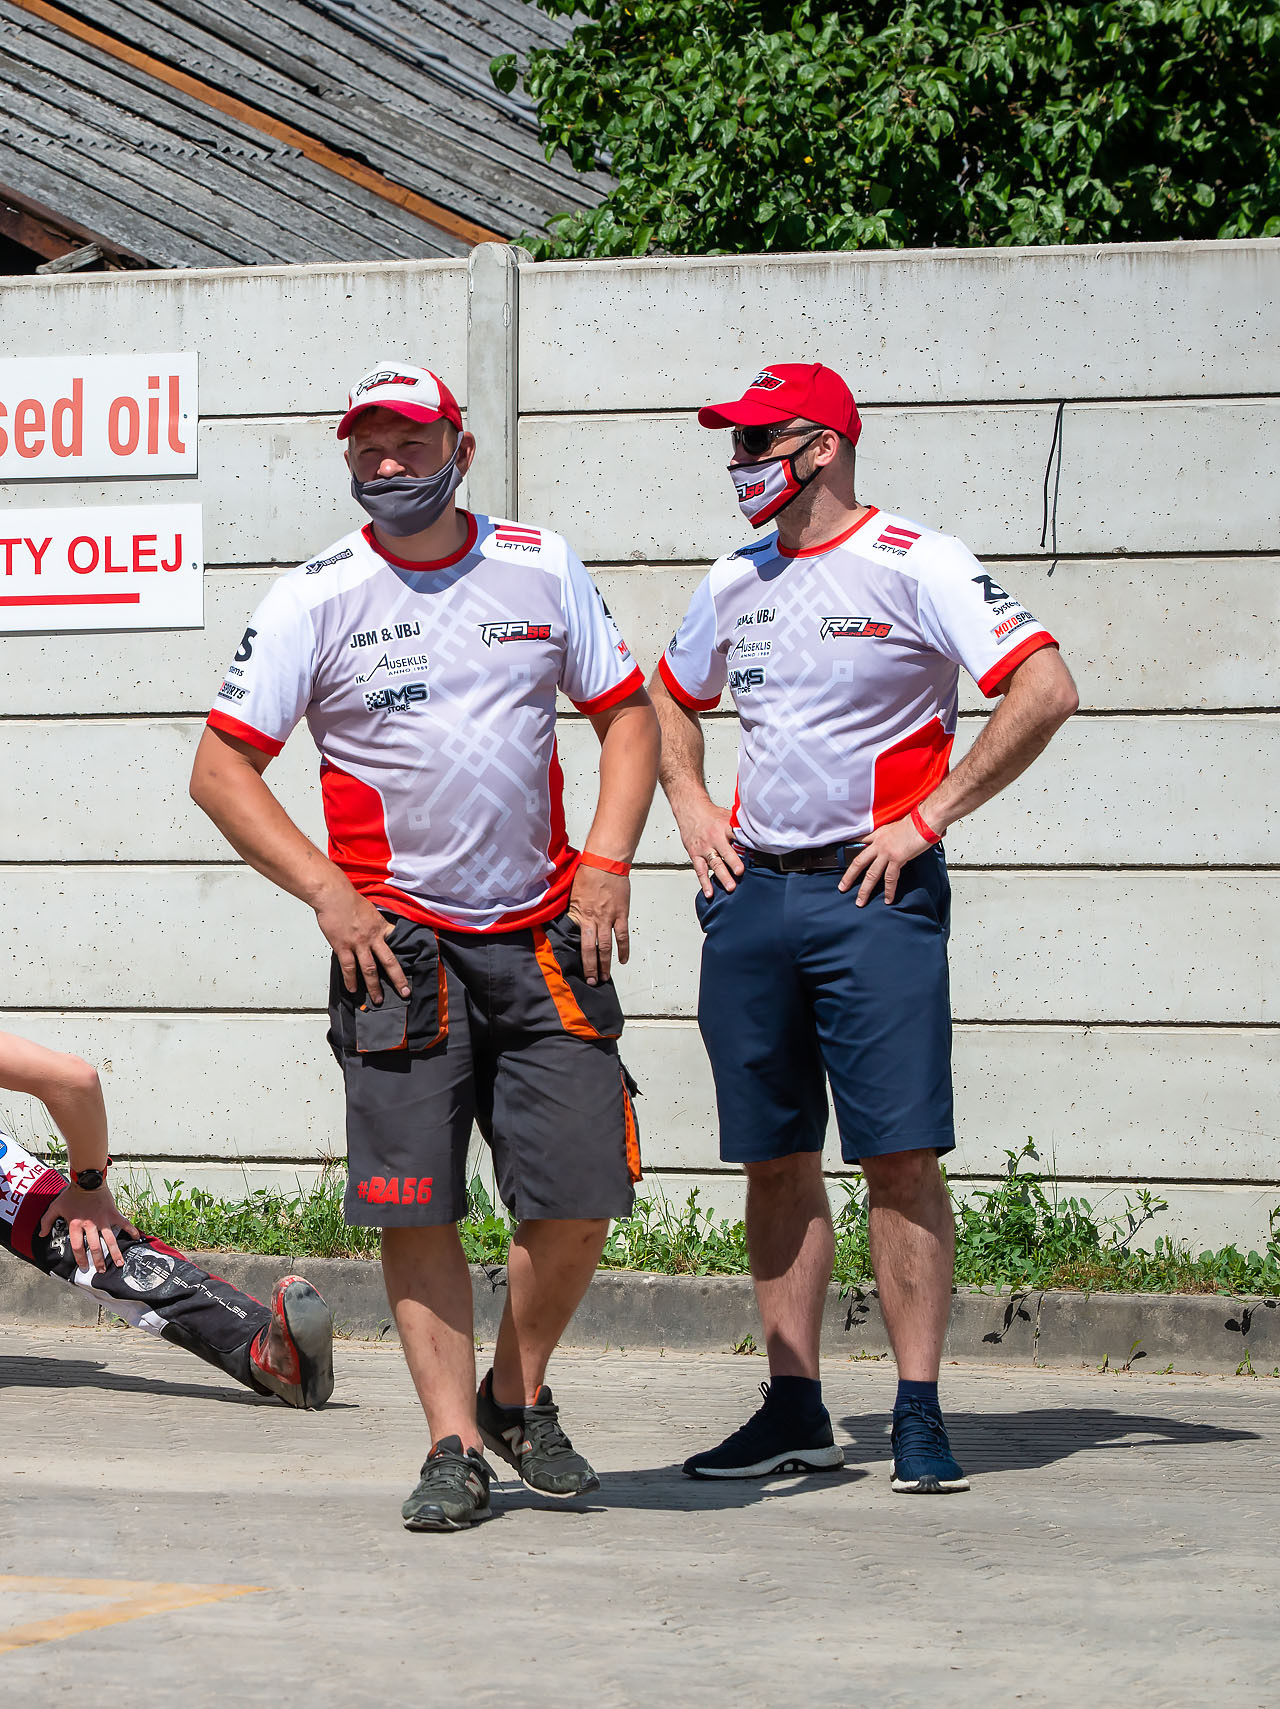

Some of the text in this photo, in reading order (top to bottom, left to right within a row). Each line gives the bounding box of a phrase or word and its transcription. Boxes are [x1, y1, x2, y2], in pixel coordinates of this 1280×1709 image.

[107, 375, 186, 457] oil
[67, 533, 183, 576] OLEJ
[496, 541, 541, 553] LATVIA
[872, 542, 907, 556] LATVIA
[756, 608, 776, 624] VBJ
[350, 622, 421, 649] JBM & VBJ
[387, 702, 411, 714] STORE
[5, 1164, 46, 1217] LATVIA
